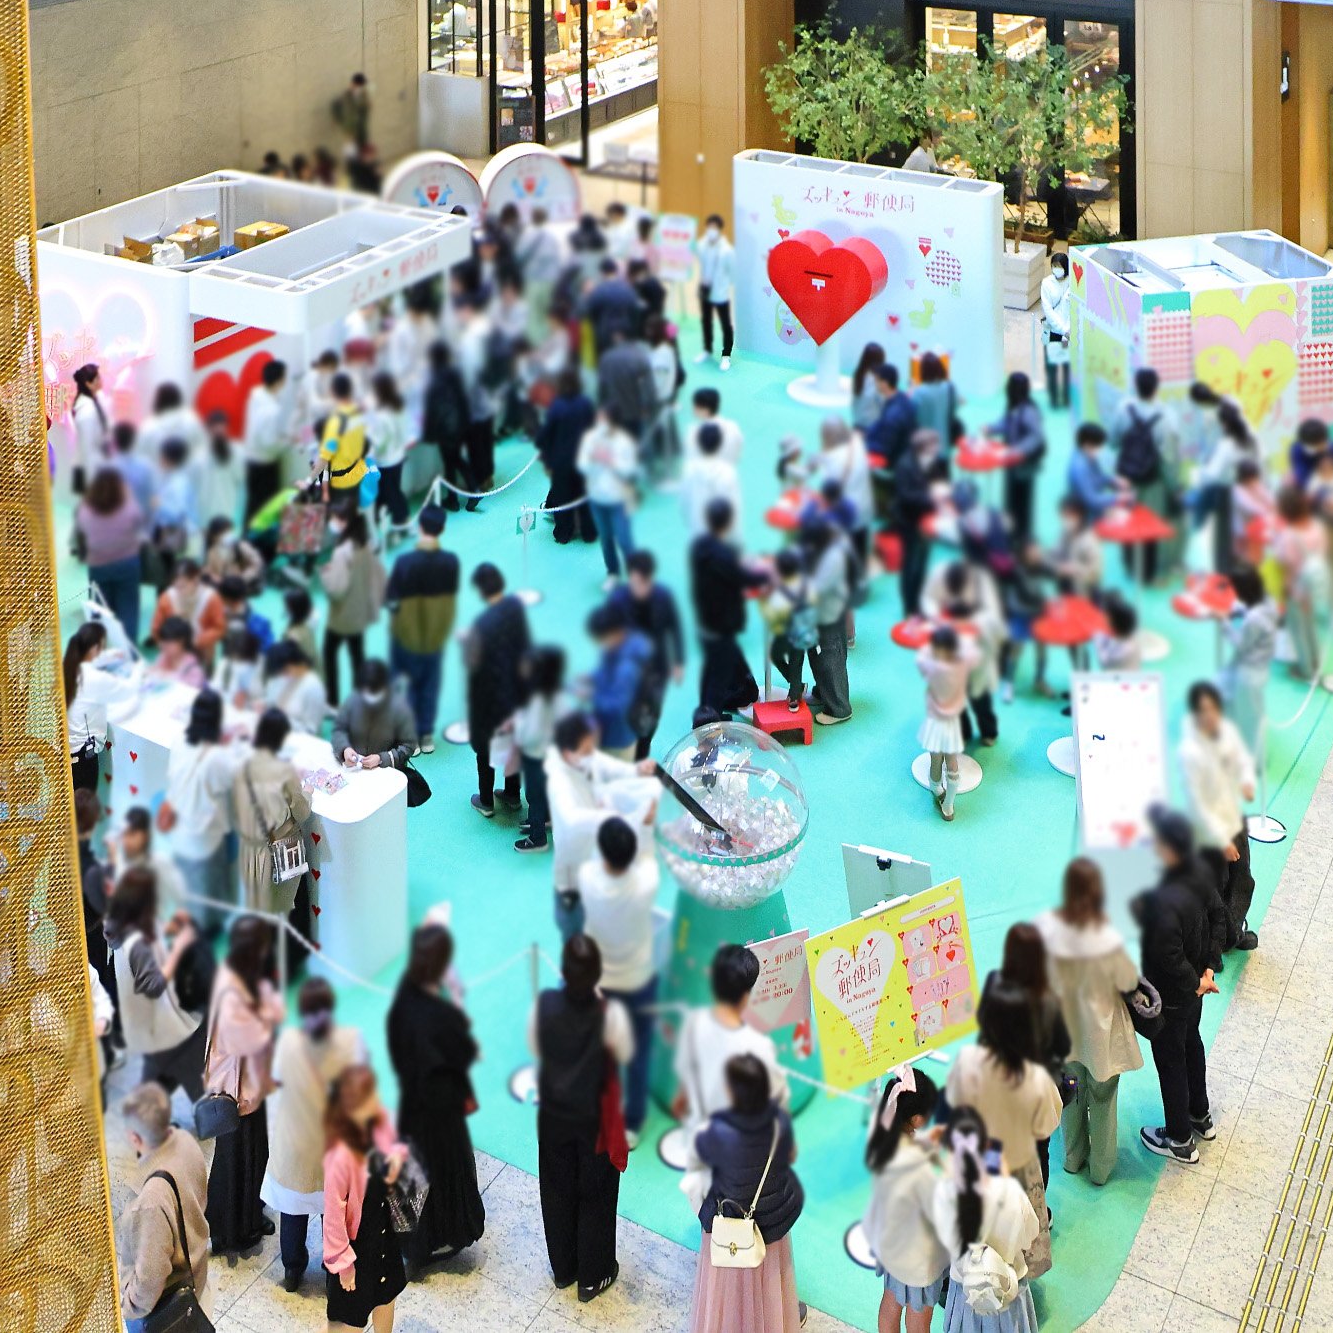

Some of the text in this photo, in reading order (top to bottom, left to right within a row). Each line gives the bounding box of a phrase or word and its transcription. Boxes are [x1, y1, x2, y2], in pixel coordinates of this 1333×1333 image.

[864, 191, 914, 212] 郵便局
[838, 958, 881, 999] 郵便局
[853, 987, 876, 1001] Nagoya
